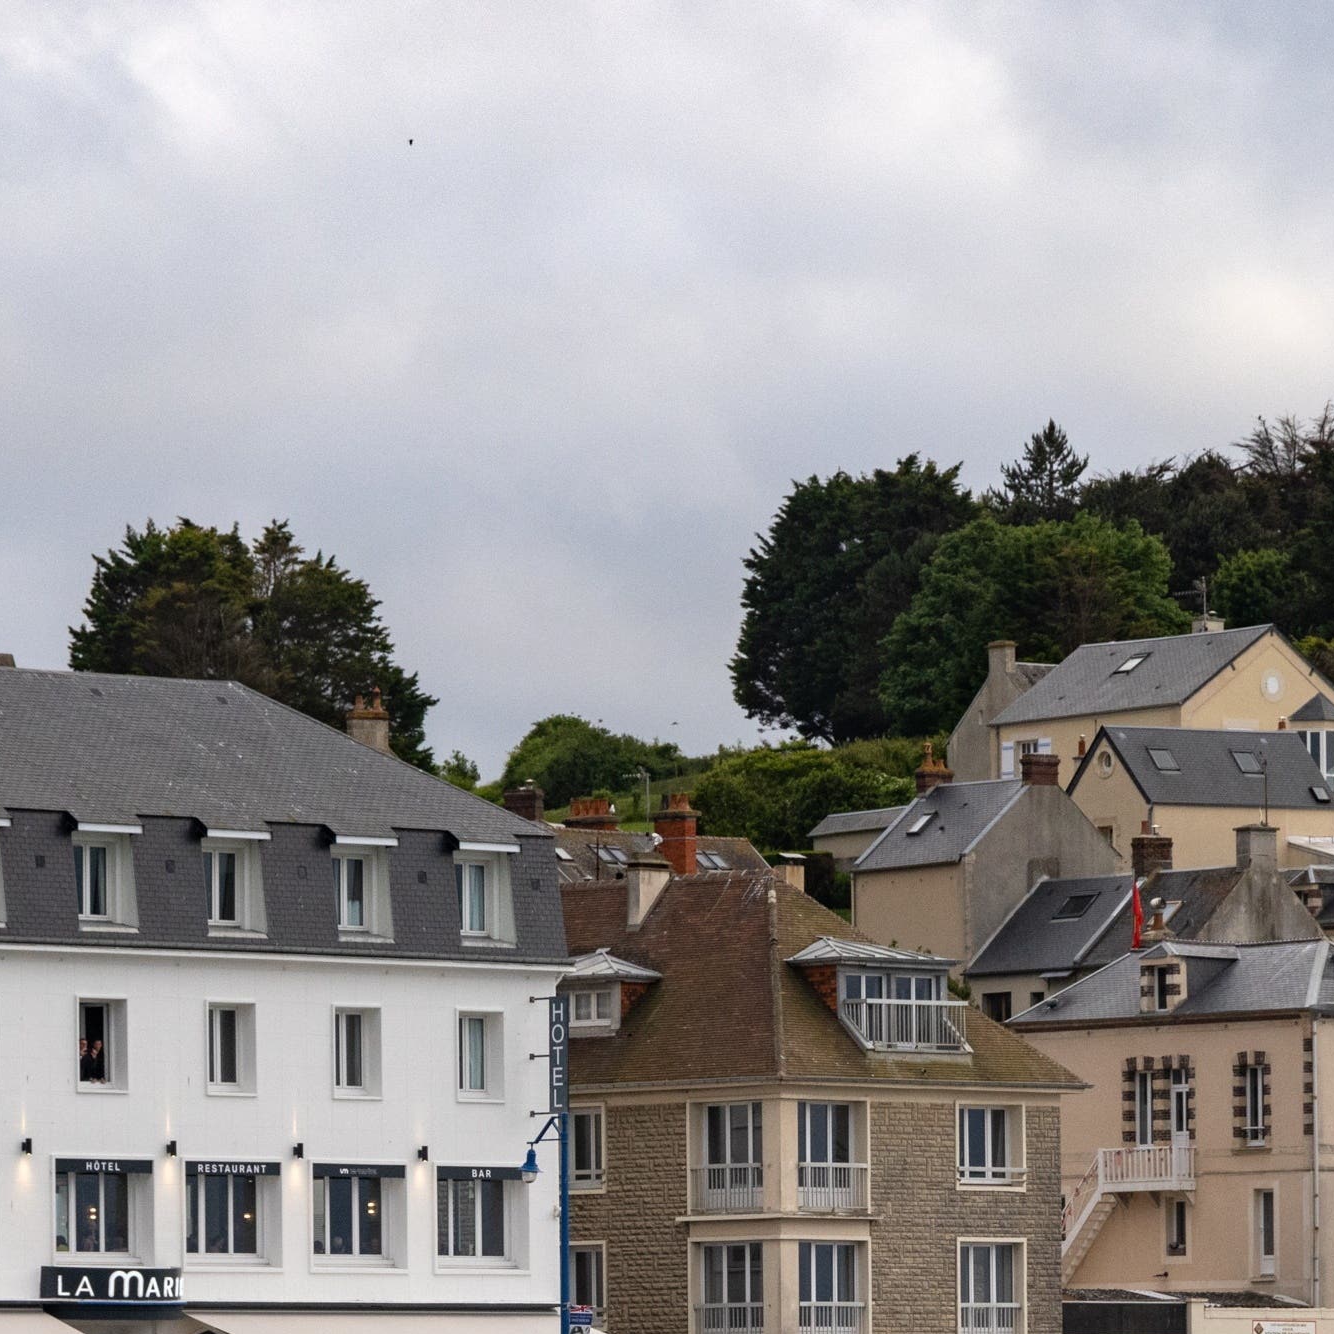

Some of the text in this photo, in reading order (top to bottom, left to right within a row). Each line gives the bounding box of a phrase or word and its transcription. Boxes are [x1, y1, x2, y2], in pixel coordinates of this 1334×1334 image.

[551, 1002, 565, 1108] HOTEL
[85, 1160, 121, 1171] HÔTEL
[197, 1163, 267, 1174] RESTAURANT
[471, 1168, 492, 1178] BAR
[57, 1274, 95, 1297] LA
